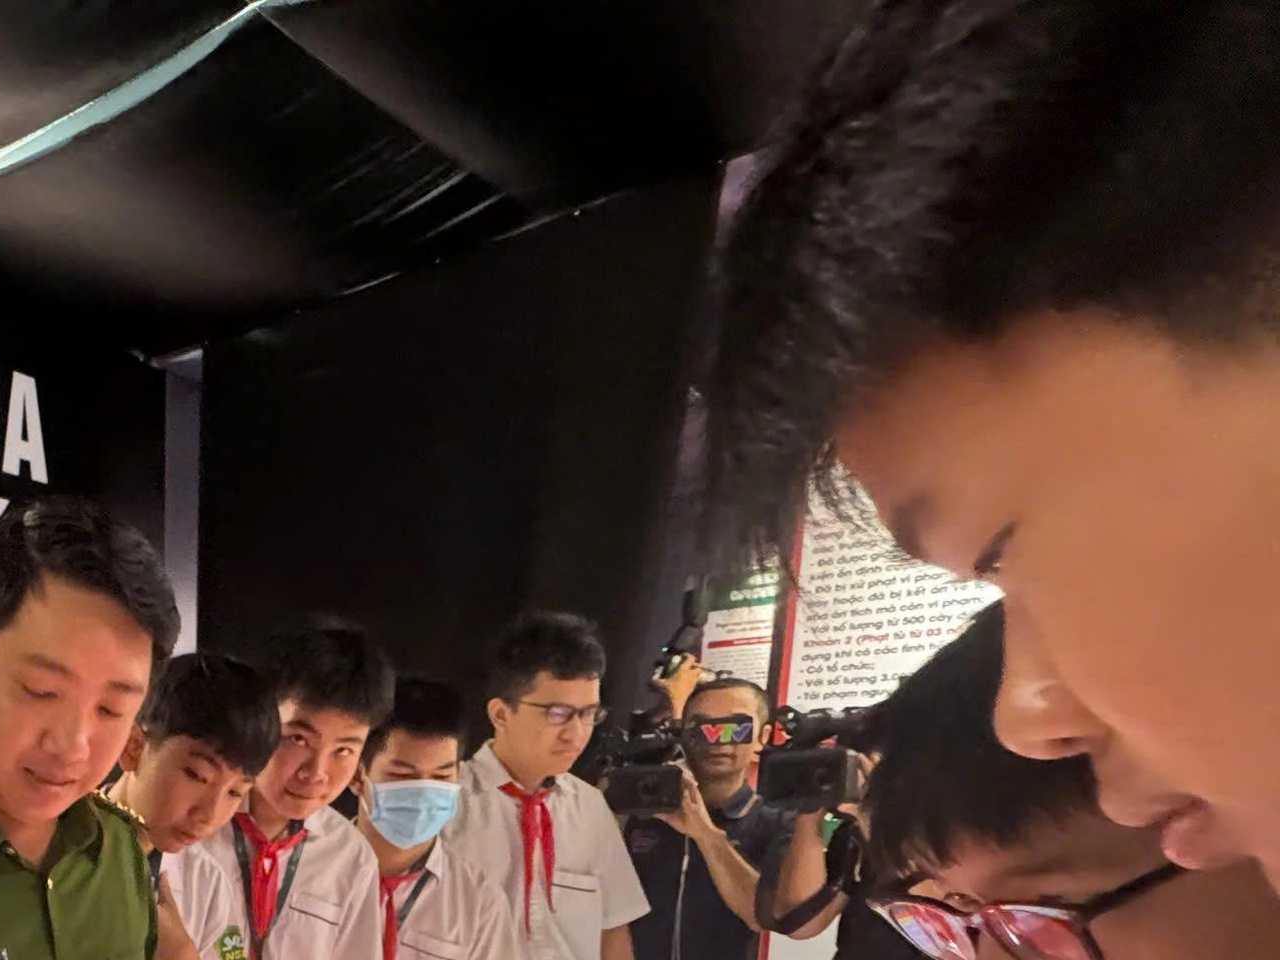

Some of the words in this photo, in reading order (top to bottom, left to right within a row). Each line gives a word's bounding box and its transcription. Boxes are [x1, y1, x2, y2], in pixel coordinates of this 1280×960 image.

[867, 576, 897, 589] phạt
[902, 615, 926, 626] 500
[801, 653, 832, 663] dụng
[834, 648, 853, 659] khi
[855, 648, 872, 658] có
[873, 645, 900, 656] các
[806, 664, 825, 675] Có
